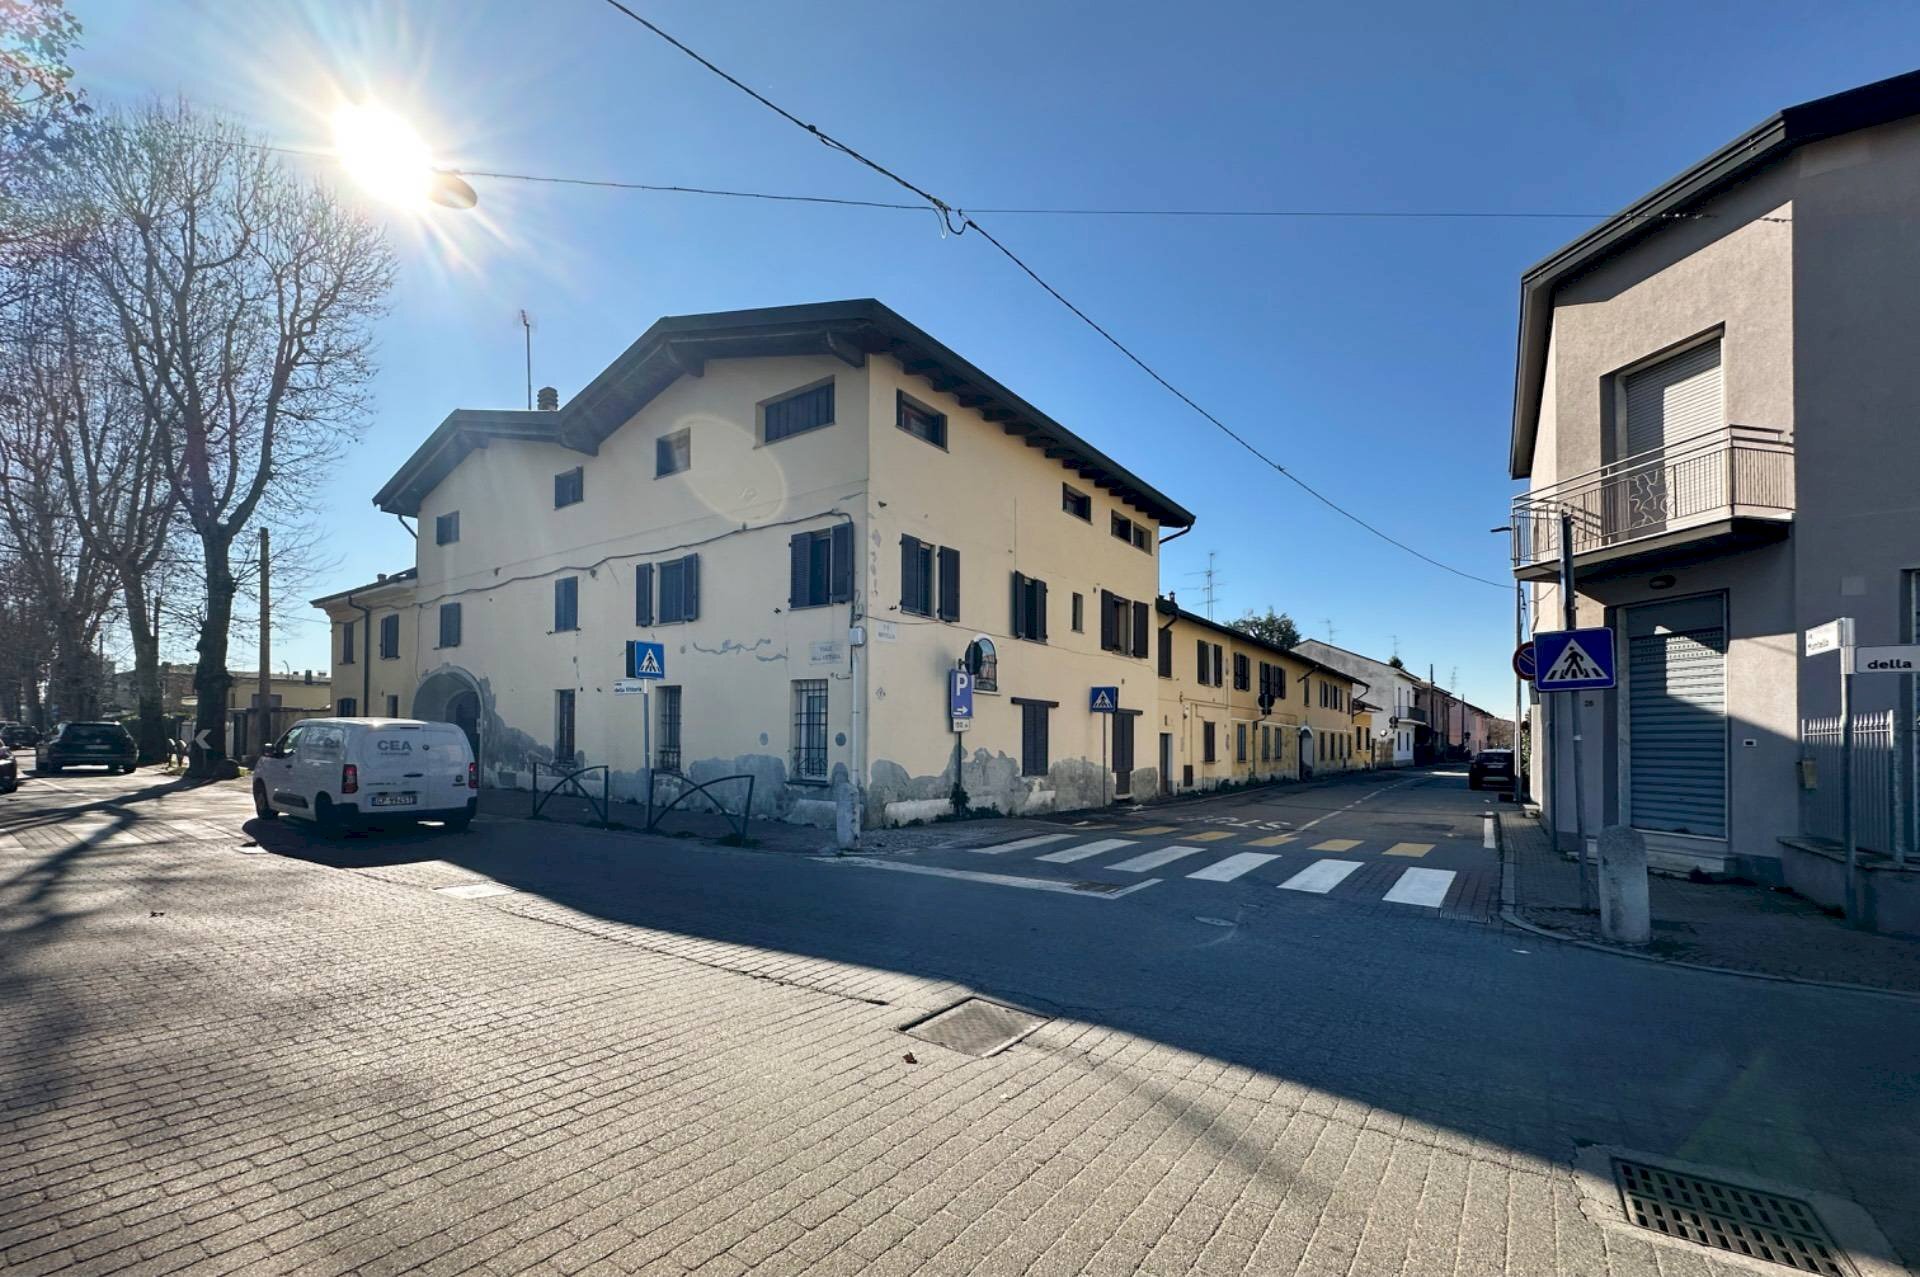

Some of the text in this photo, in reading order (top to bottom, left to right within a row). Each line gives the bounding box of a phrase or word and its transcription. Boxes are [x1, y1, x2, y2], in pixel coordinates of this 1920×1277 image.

[1867, 659, 1912, 670] della
[956, 673, 969, 696] P
[377, 740, 413, 751] CEA
